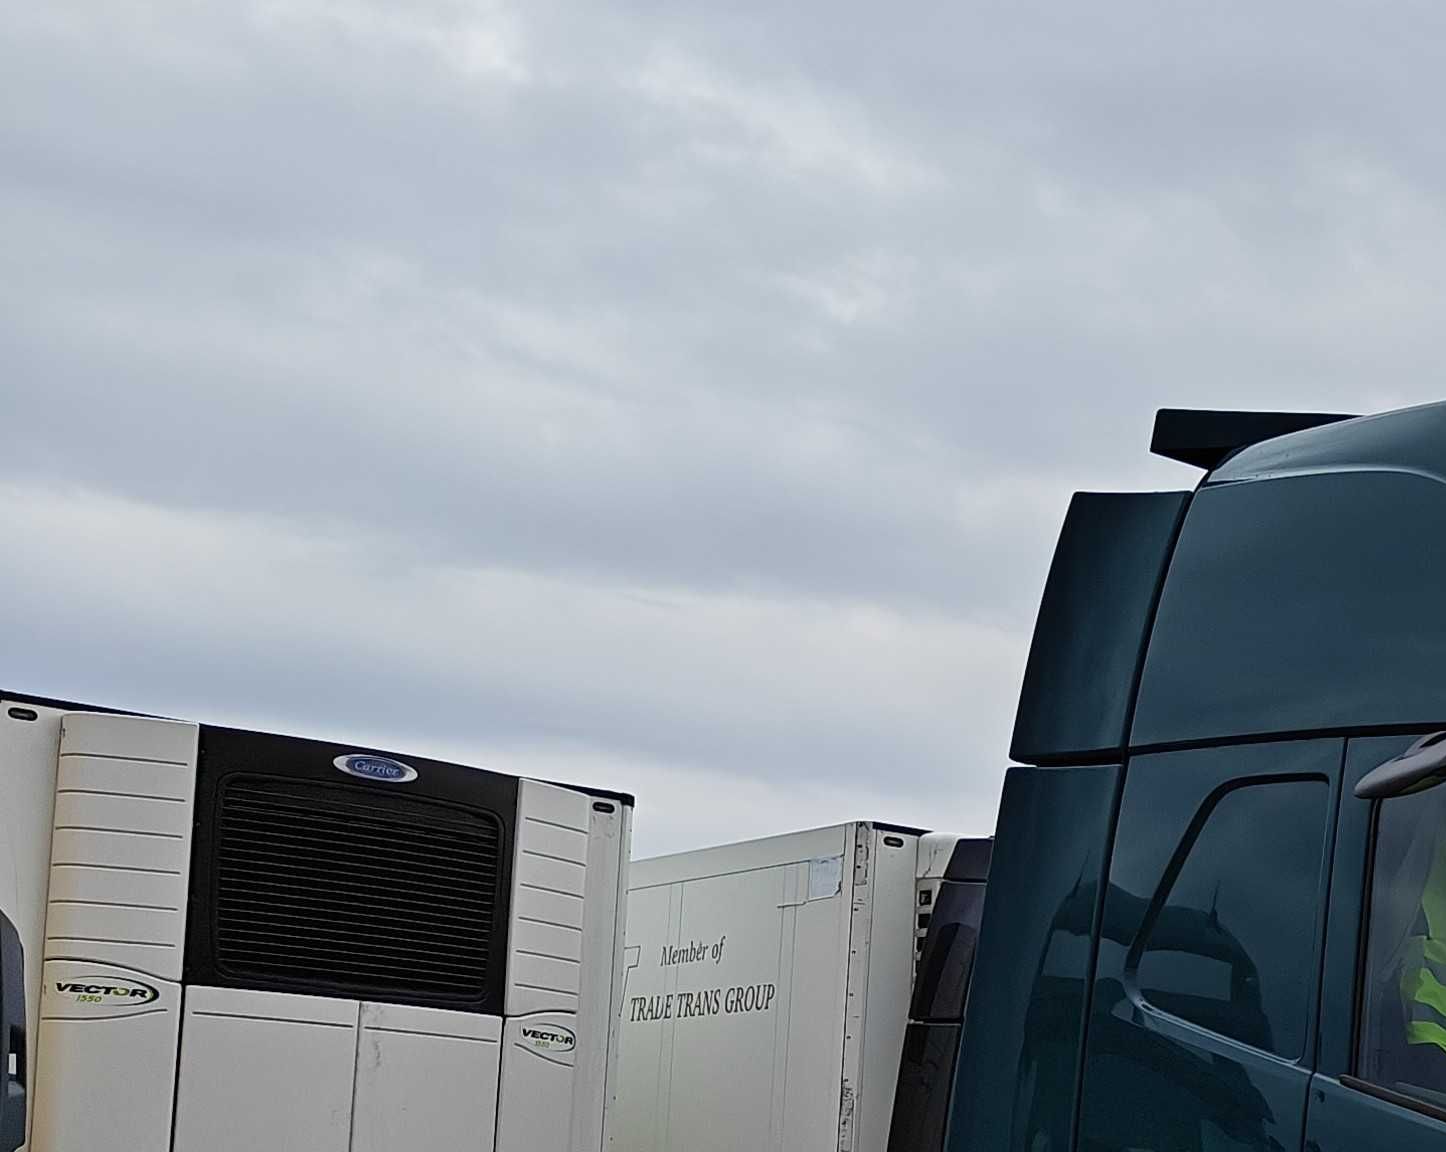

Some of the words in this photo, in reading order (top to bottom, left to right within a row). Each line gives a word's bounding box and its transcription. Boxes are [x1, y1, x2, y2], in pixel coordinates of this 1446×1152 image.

[355, 760, 399, 777] Carrier
[660, 940, 709, 967] Member
[711, 935, 726, 965] of
[56, 982, 148, 998] VECTOR
[676, 988, 721, 1018] TRANS
[724, 983, 776, 1014] GROUP
[522, 1028, 573, 1045] VECTOR
